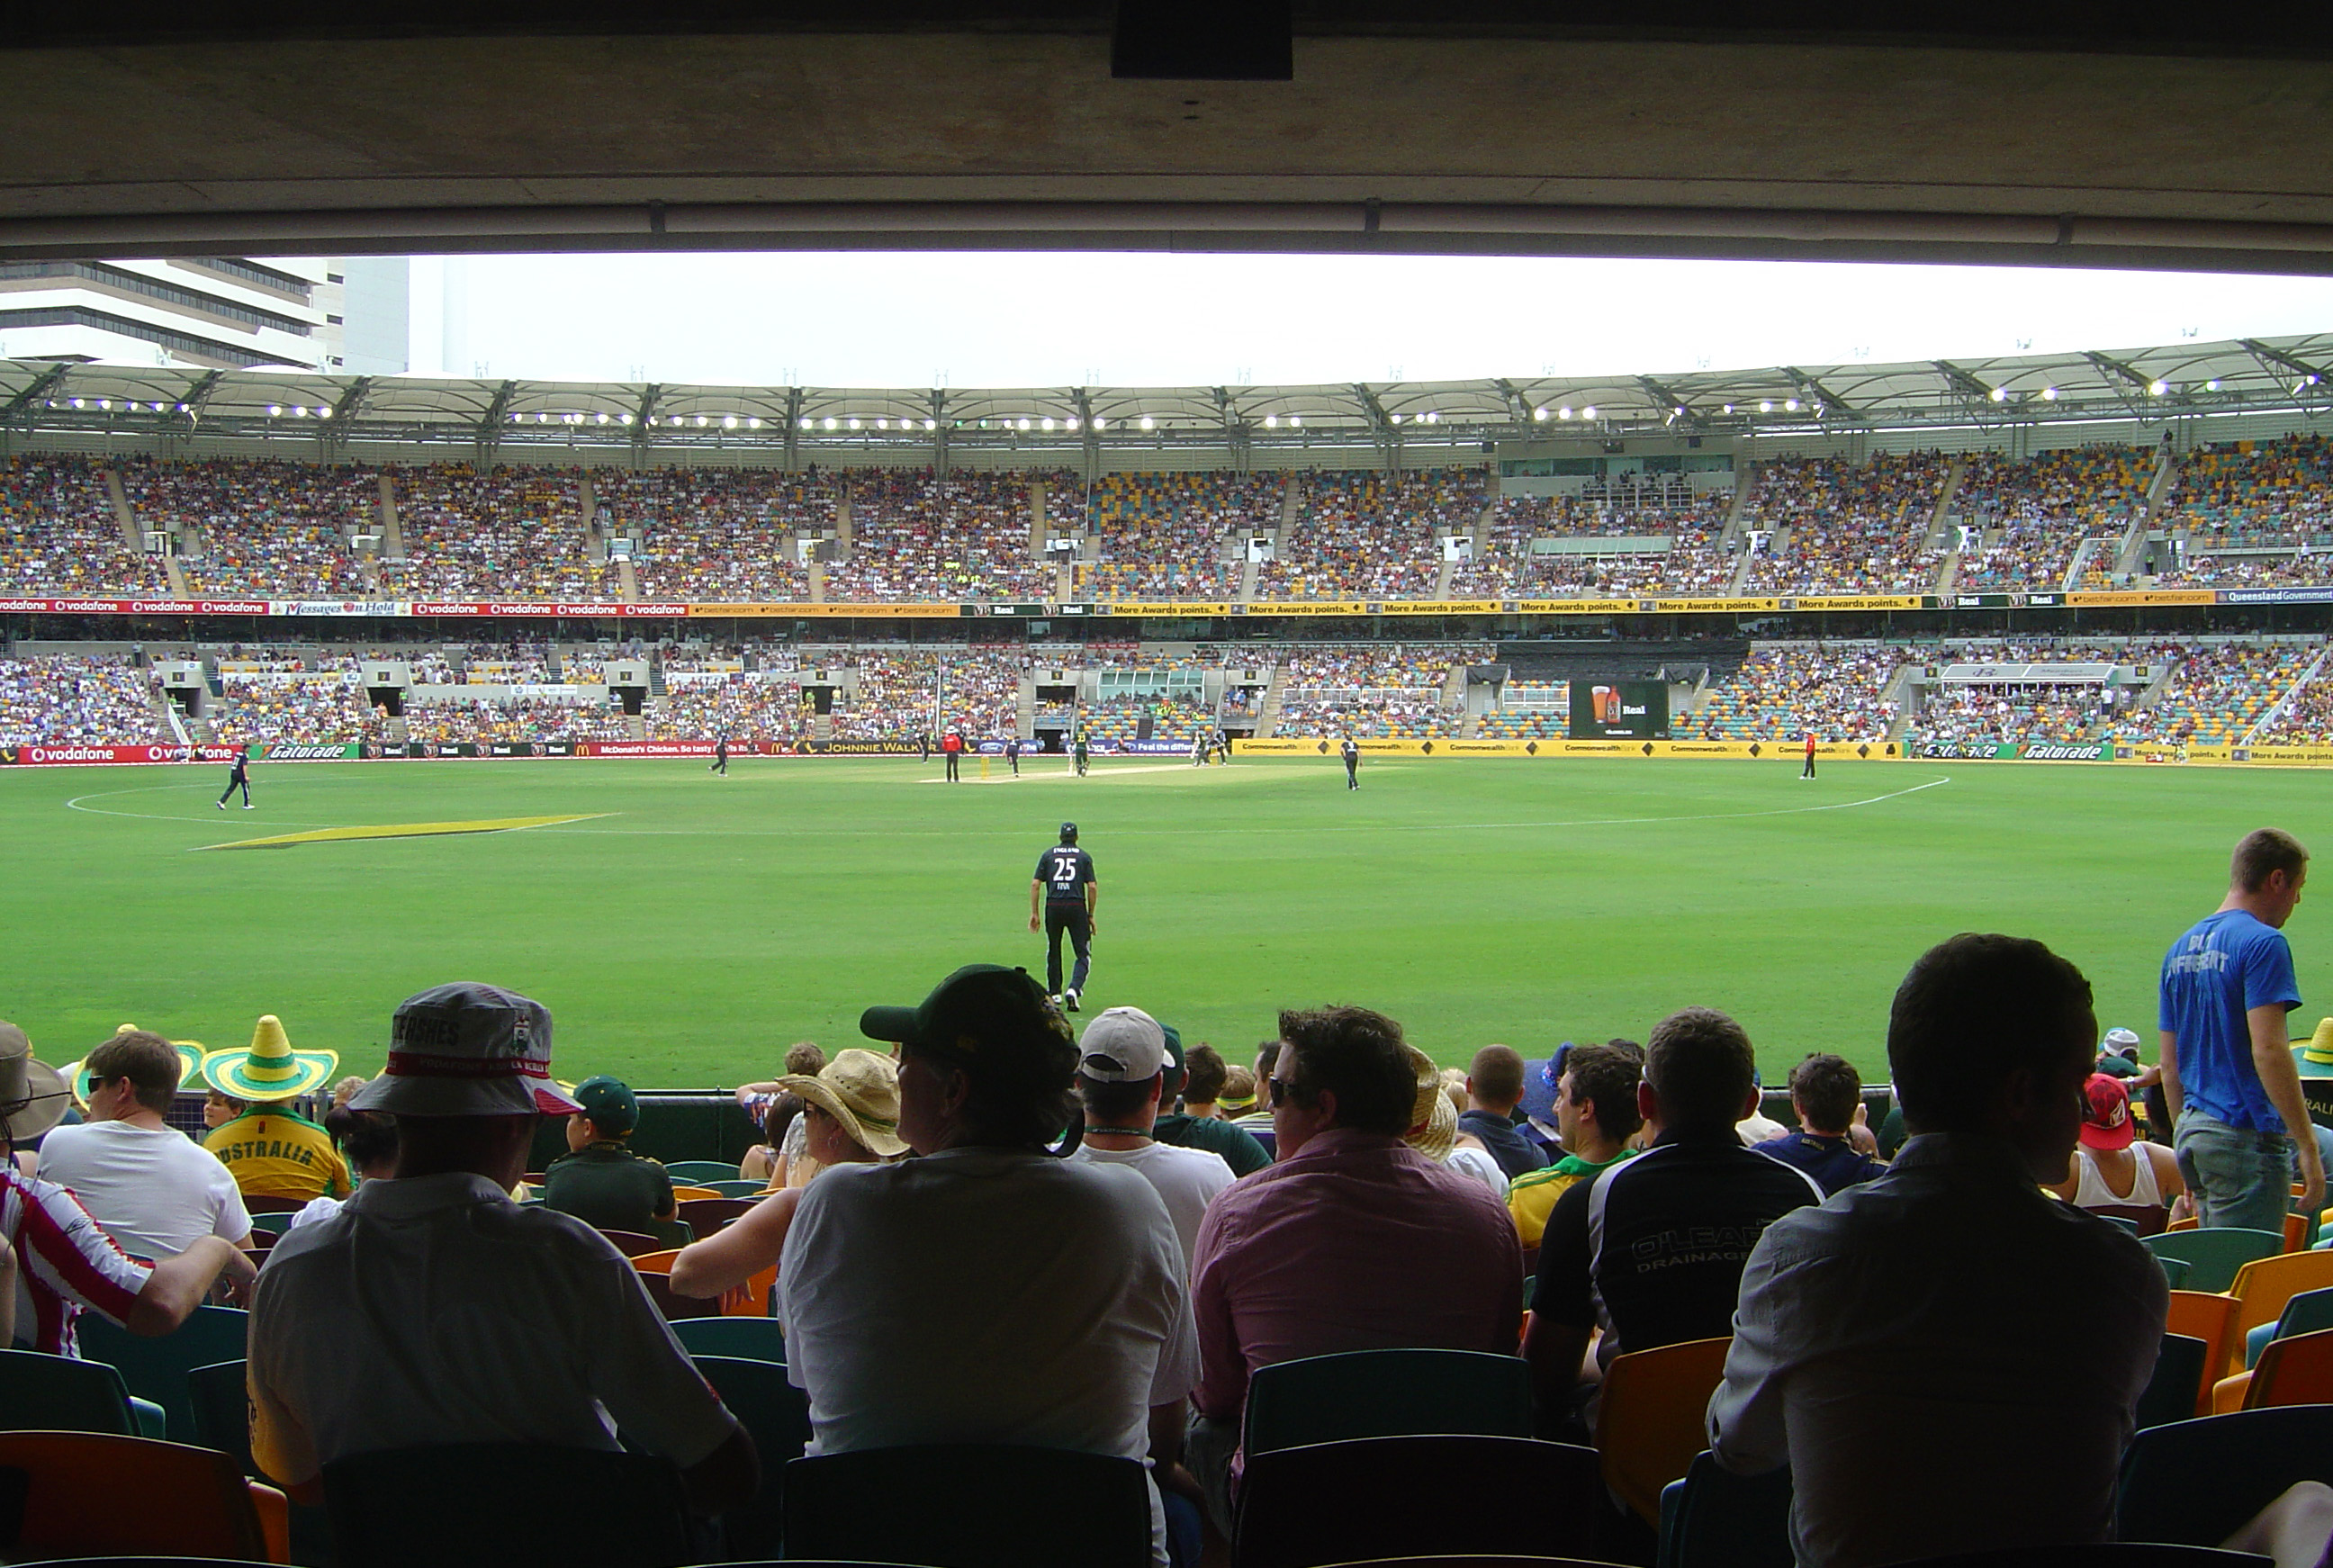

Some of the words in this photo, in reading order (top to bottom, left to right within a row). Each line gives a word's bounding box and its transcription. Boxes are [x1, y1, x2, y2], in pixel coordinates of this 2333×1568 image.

[1798, 599, 1825, 608] More
[1827, 599, 1864, 608] Awards
[1867, 599, 1902, 609] points.
[1958, 597, 1979, 606] Real
[2031, 595, 2053, 604] Real
[67, 601, 117, 611] vodafone
[144, 601, 194, 611] vodafone
[213, 602, 263, 612] vodafone
[286, 601, 342, 616] Messages
[365, 600, 394, 610] Hold
[428, 603, 478, 613] vodafone
[502, 603, 551, 613] vodafone
[569, 605, 617, 614] vodafone
[636, 605, 685, 614] vodafone
[994, 606, 1014, 614] Real
[1062, 606, 1083, 614] Real
[1276, 605, 1312, 613] Awards
[1315, 605, 1347, 615] points.
[1384, 604, 1410, 612] More
[1413, 604, 1448, 612] Awards
[1451, 603, 1483, 613] points.
[1521, 603, 1546, 611] More
[1548, 603, 1584, 611] Awards
[1588, 602, 1621, 612] points.
[1659, 601, 1684, 609] More
[1686, 601, 1723, 609] Awards
[1725, 600, 1760, 611] points.
[1114, 606, 1140, 614] More
[1142, 606, 1177, 614] Awards
[1180, 606, 1212, 616] points.
[1623, 706, 1645, 715] Real
[1077, 734, 1086, 743] 23
[269, 745, 347, 759] Gatorade
[384, 747, 402, 755] Real
[441, 746, 459, 754] Real
[493, 746, 511, 754] Real
[548, 745, 566, 753] Real
[600, 745, 645, 753] McDonald's
[647, 745, 680, 753] Chicken.
[680, 745, 691, 753] So
[692, 745, 711, 753] tasty
[824, 743, 880, 752] JOHNNIE
[883, 742, 939, 752] WALKR.
[2023, 744, 2103, 759] Gatorade
[48, 747, 114, 760] vodafone
[2274, 752, 2304, 760] Awards
[1053, 858, 1076, 881] 25
